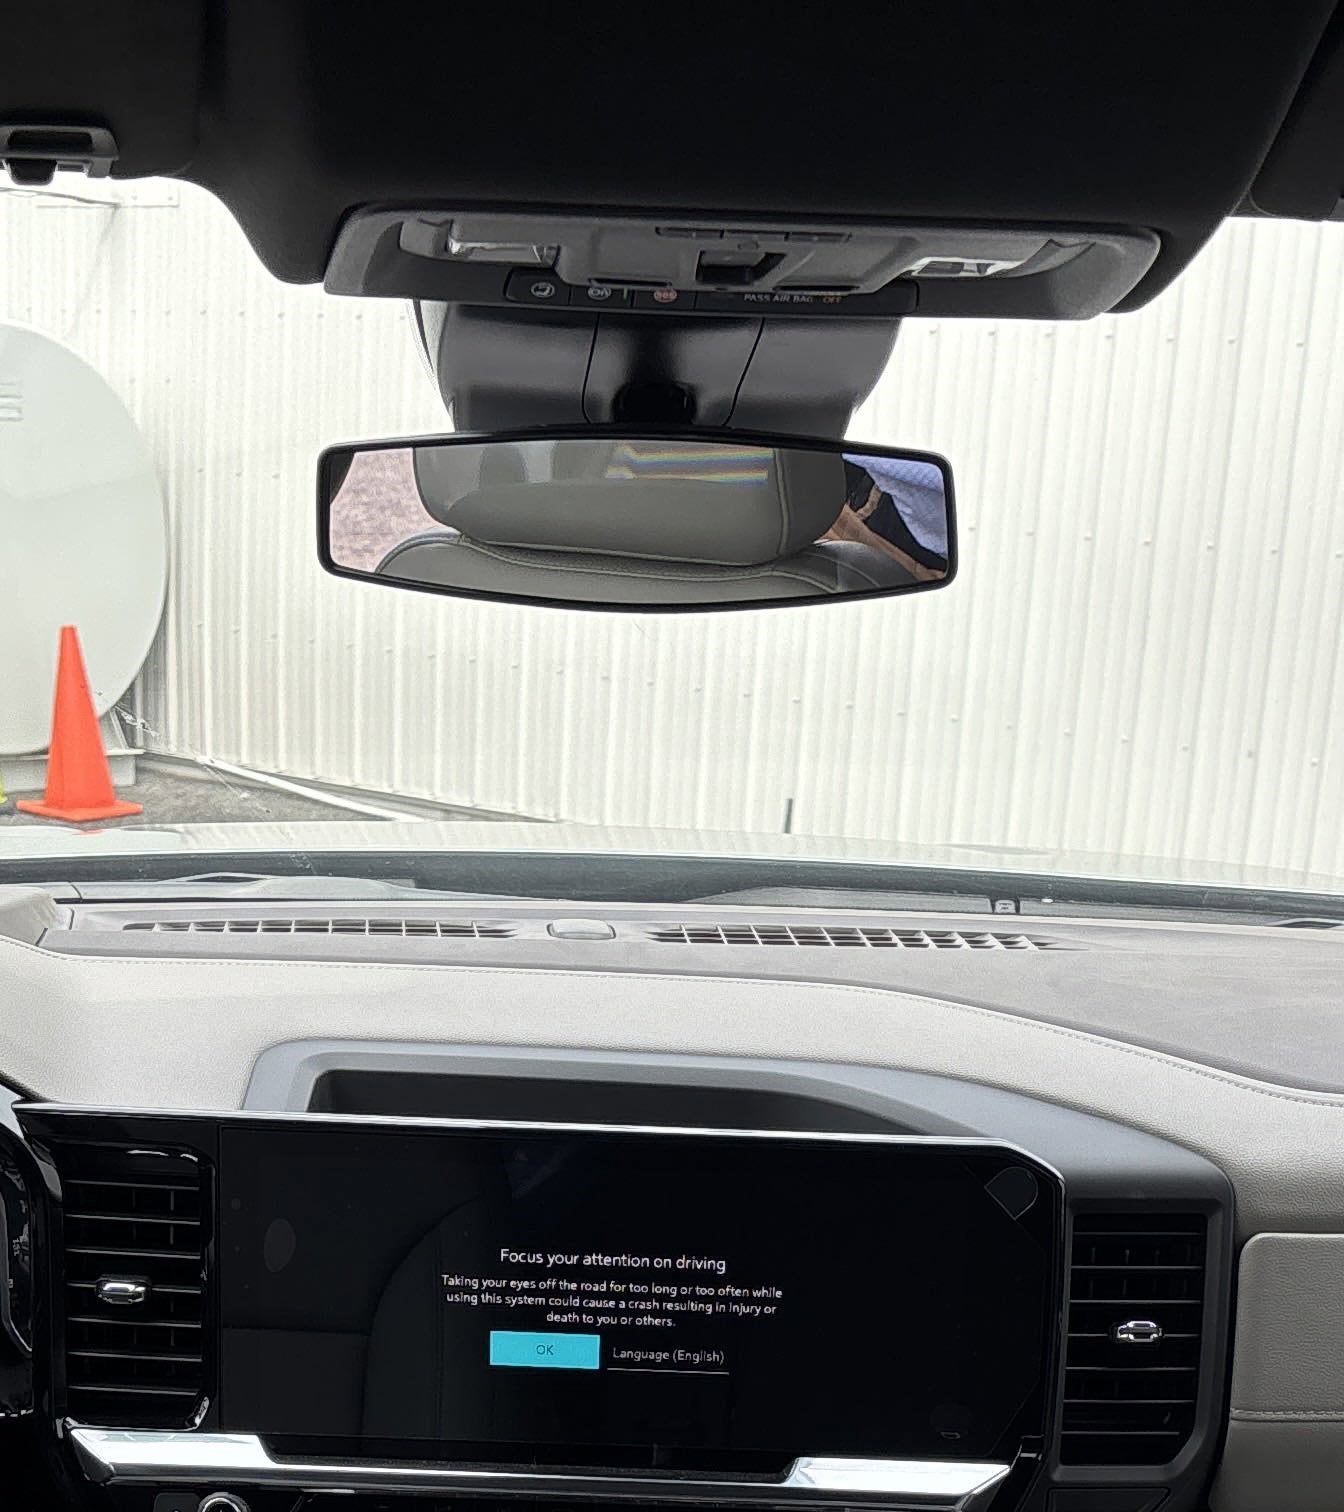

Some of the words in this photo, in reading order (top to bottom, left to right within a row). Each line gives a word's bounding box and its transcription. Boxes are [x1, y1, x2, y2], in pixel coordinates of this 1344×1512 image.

[744, 293, 769, 303] PASS
[771, 293, 791, 304] AIR
[500, 1248, 544, 1265] Focus
[546, 1251, 579, 1269] your
[582, 1251, 651, 1269] attention
[653, 1256, 673, 1270] on
[675, 1255, 727, 1275] driving
[441, 1274, 479, 1291] Taking
[481, 1279, 508, 1292] your
[509, 1279, 537, 1293] eyes
[538, 1278, 558, 1291] off
[558, 1279, 578, 1291] the
[580, 1280, 607, 1293] road
[609, 1280, 627, 1293] for
[628, 1282, 649, 1294] too
[651, 1282, 678, 1298] long
[679, 1285, 693, 1296] or
[695, 1285, 715, 1296] too
[717, 1284, 750, 1298] often
[752, 1286, 784, 1299] while
[446, 1291, 479, 1307] using
[480, 1293, 503, 1306] this
[504, 1294, 546, 1310] system
[548, 1294, 580, 1308] could
[582, 1298, 617, 1310] cause
[619, 1300, 626, 1309] a
[628, 1298, 661, 1312] crash
[662, 1299, 713, 1315] resulting
[715, 1301, 726, 1314] in
[728, 1301, 762, 1317] injury
[763, 1304, 777, 1315] or
[546, 1311, 580, 1324] death
[581, 1314, 595, 1325] to
[596, 1315, 618, 1328] you
[619, 1316, 633, 1327] or
[635, 1314, 677, 1328] others.
[535, 1343, 554, 1357] OK
[612, 1347, 670, 1362] Language
[673, 1348, 725, 1365] (English)
